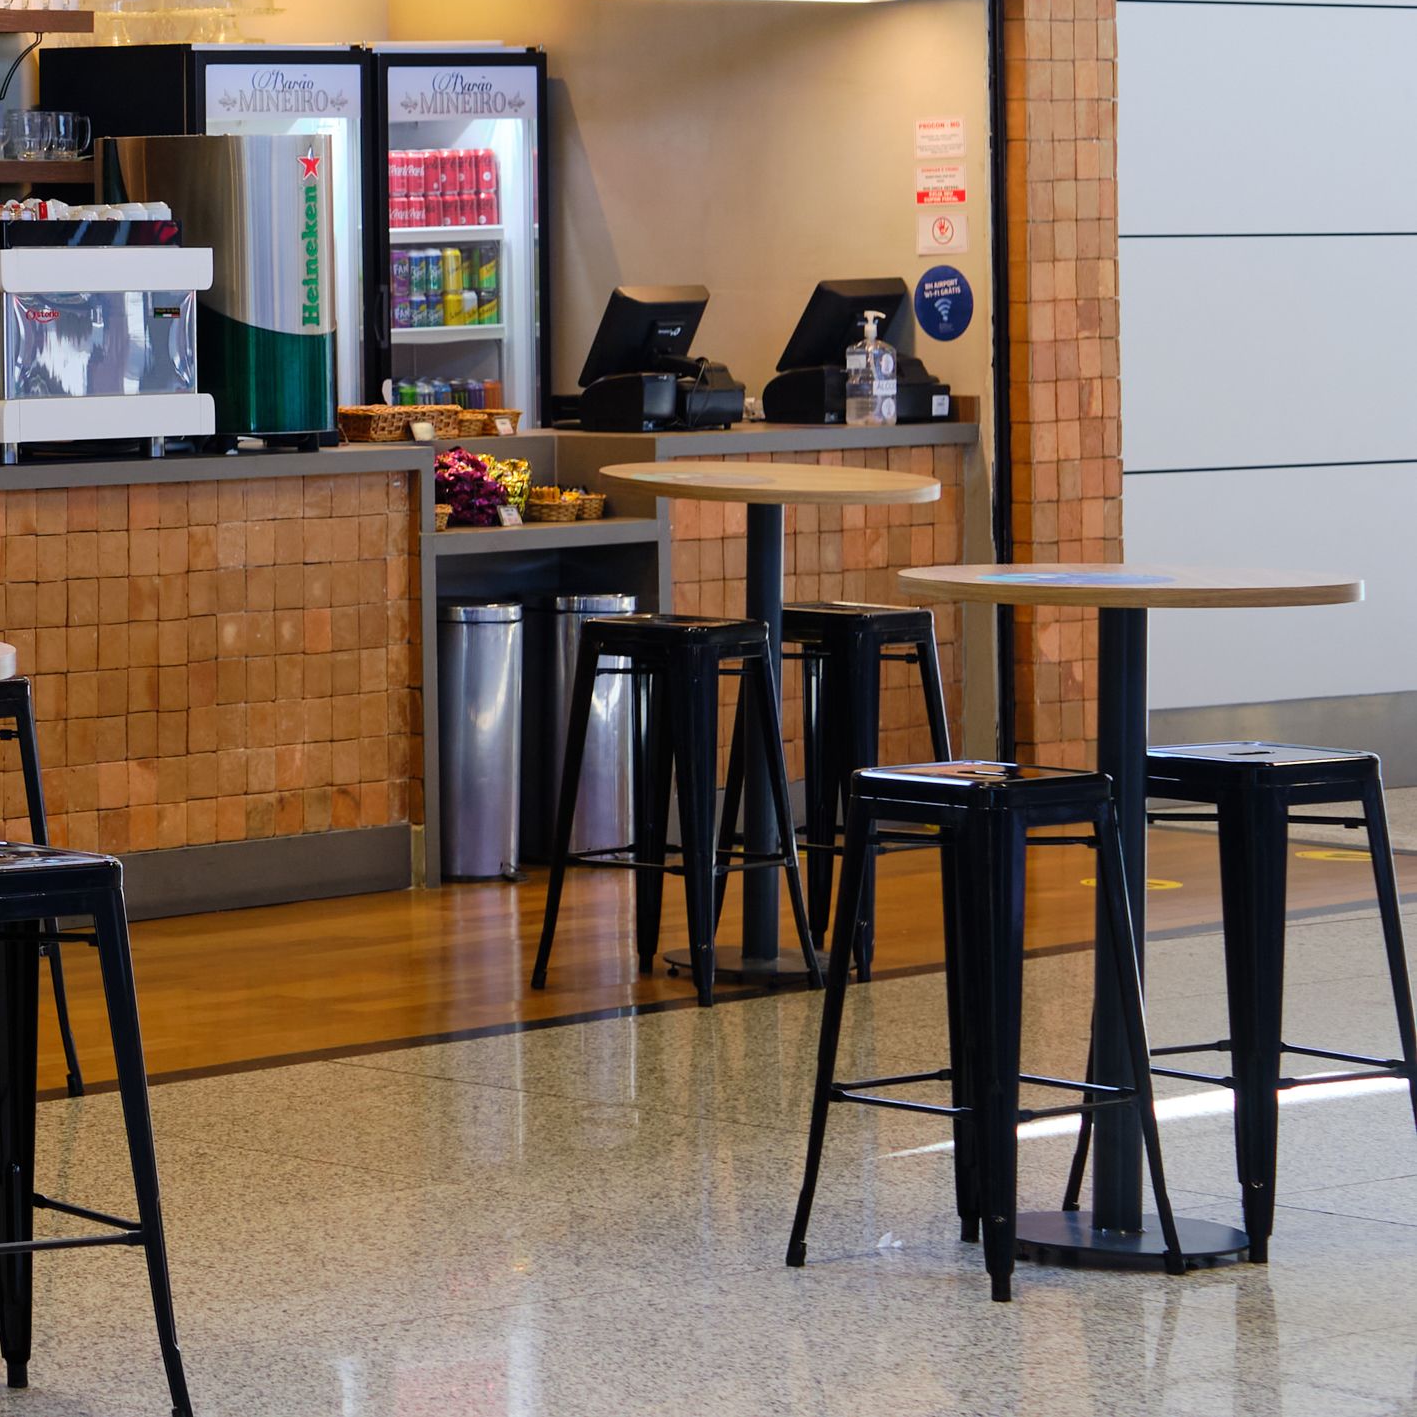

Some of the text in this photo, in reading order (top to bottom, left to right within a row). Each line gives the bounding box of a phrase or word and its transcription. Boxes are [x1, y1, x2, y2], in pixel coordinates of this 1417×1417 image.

[238, 88, 329, 113] MINEIRO
[419, 91, 507, 114] MINEIRO
[302, 184, 320, 326] Heineken
